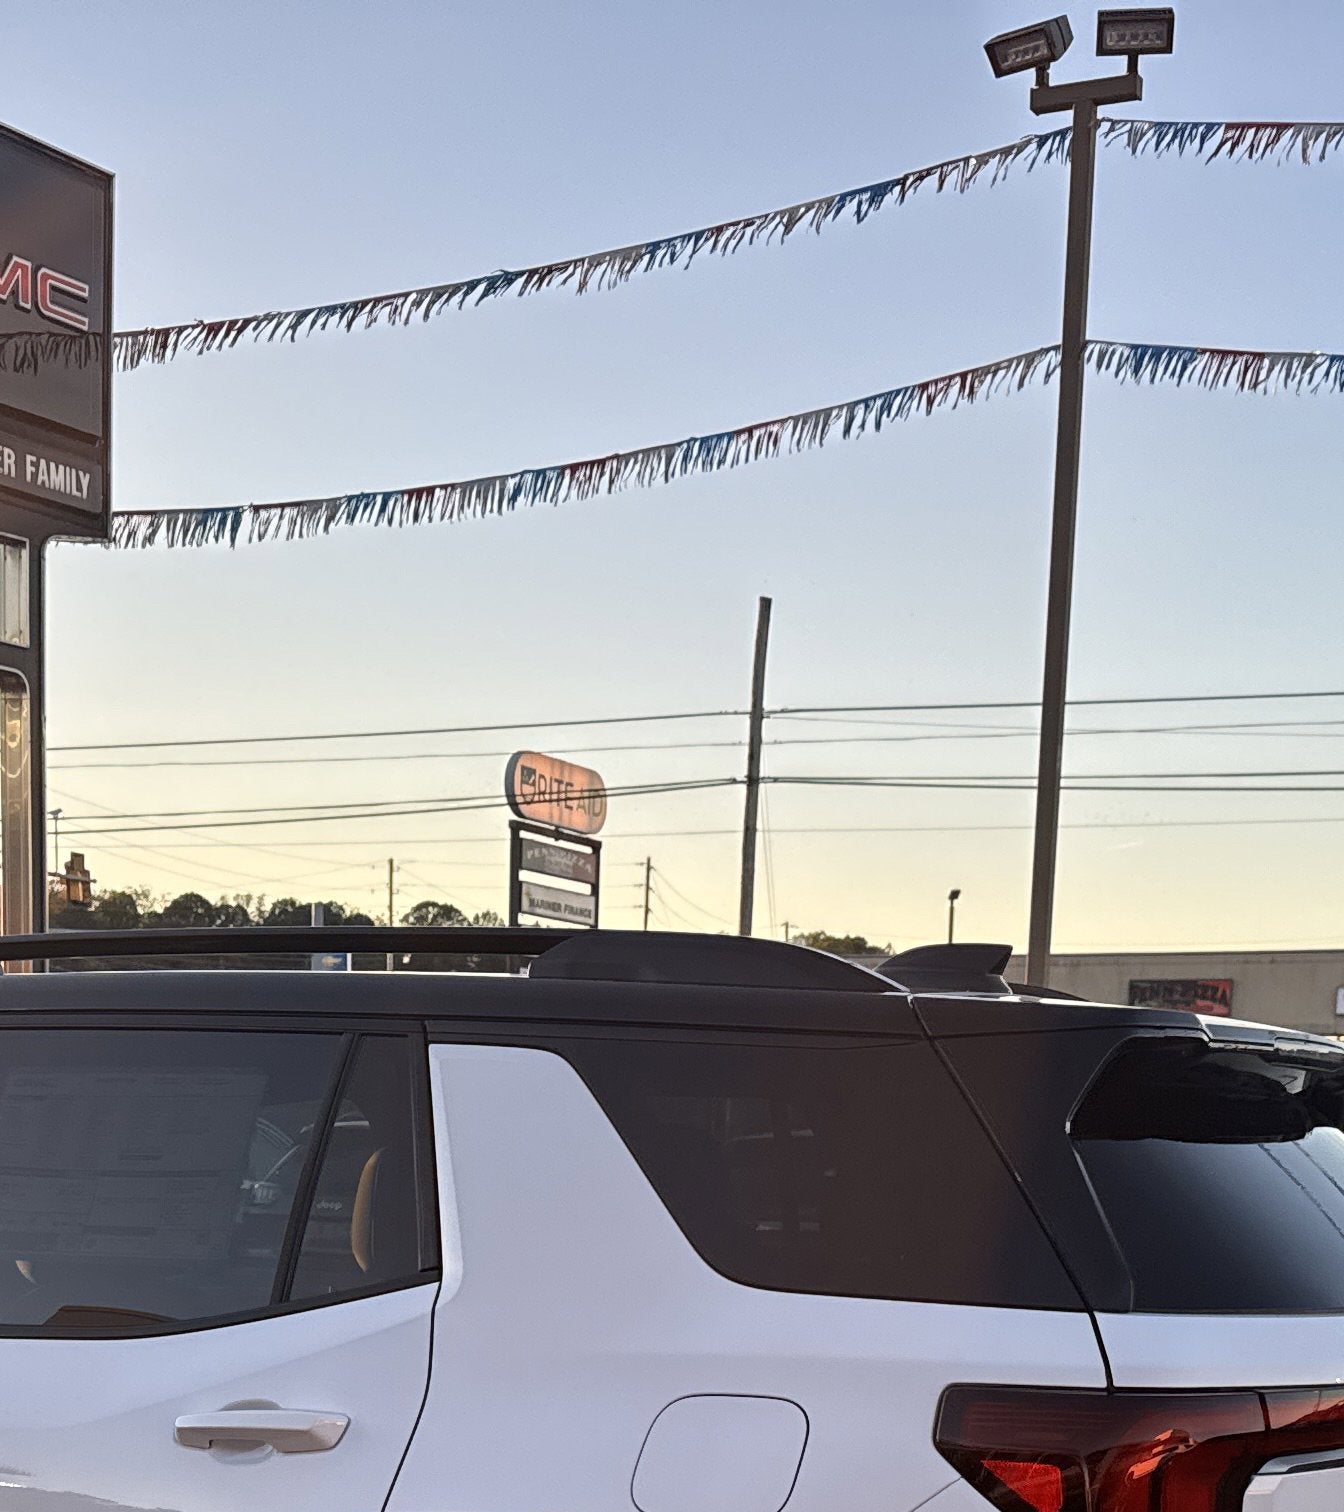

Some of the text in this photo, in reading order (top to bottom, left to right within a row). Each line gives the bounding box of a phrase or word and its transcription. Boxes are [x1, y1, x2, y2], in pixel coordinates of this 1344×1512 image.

[26, 454, 91, 499] FAMILY
[538, 773, 604, 818] RITE AID
